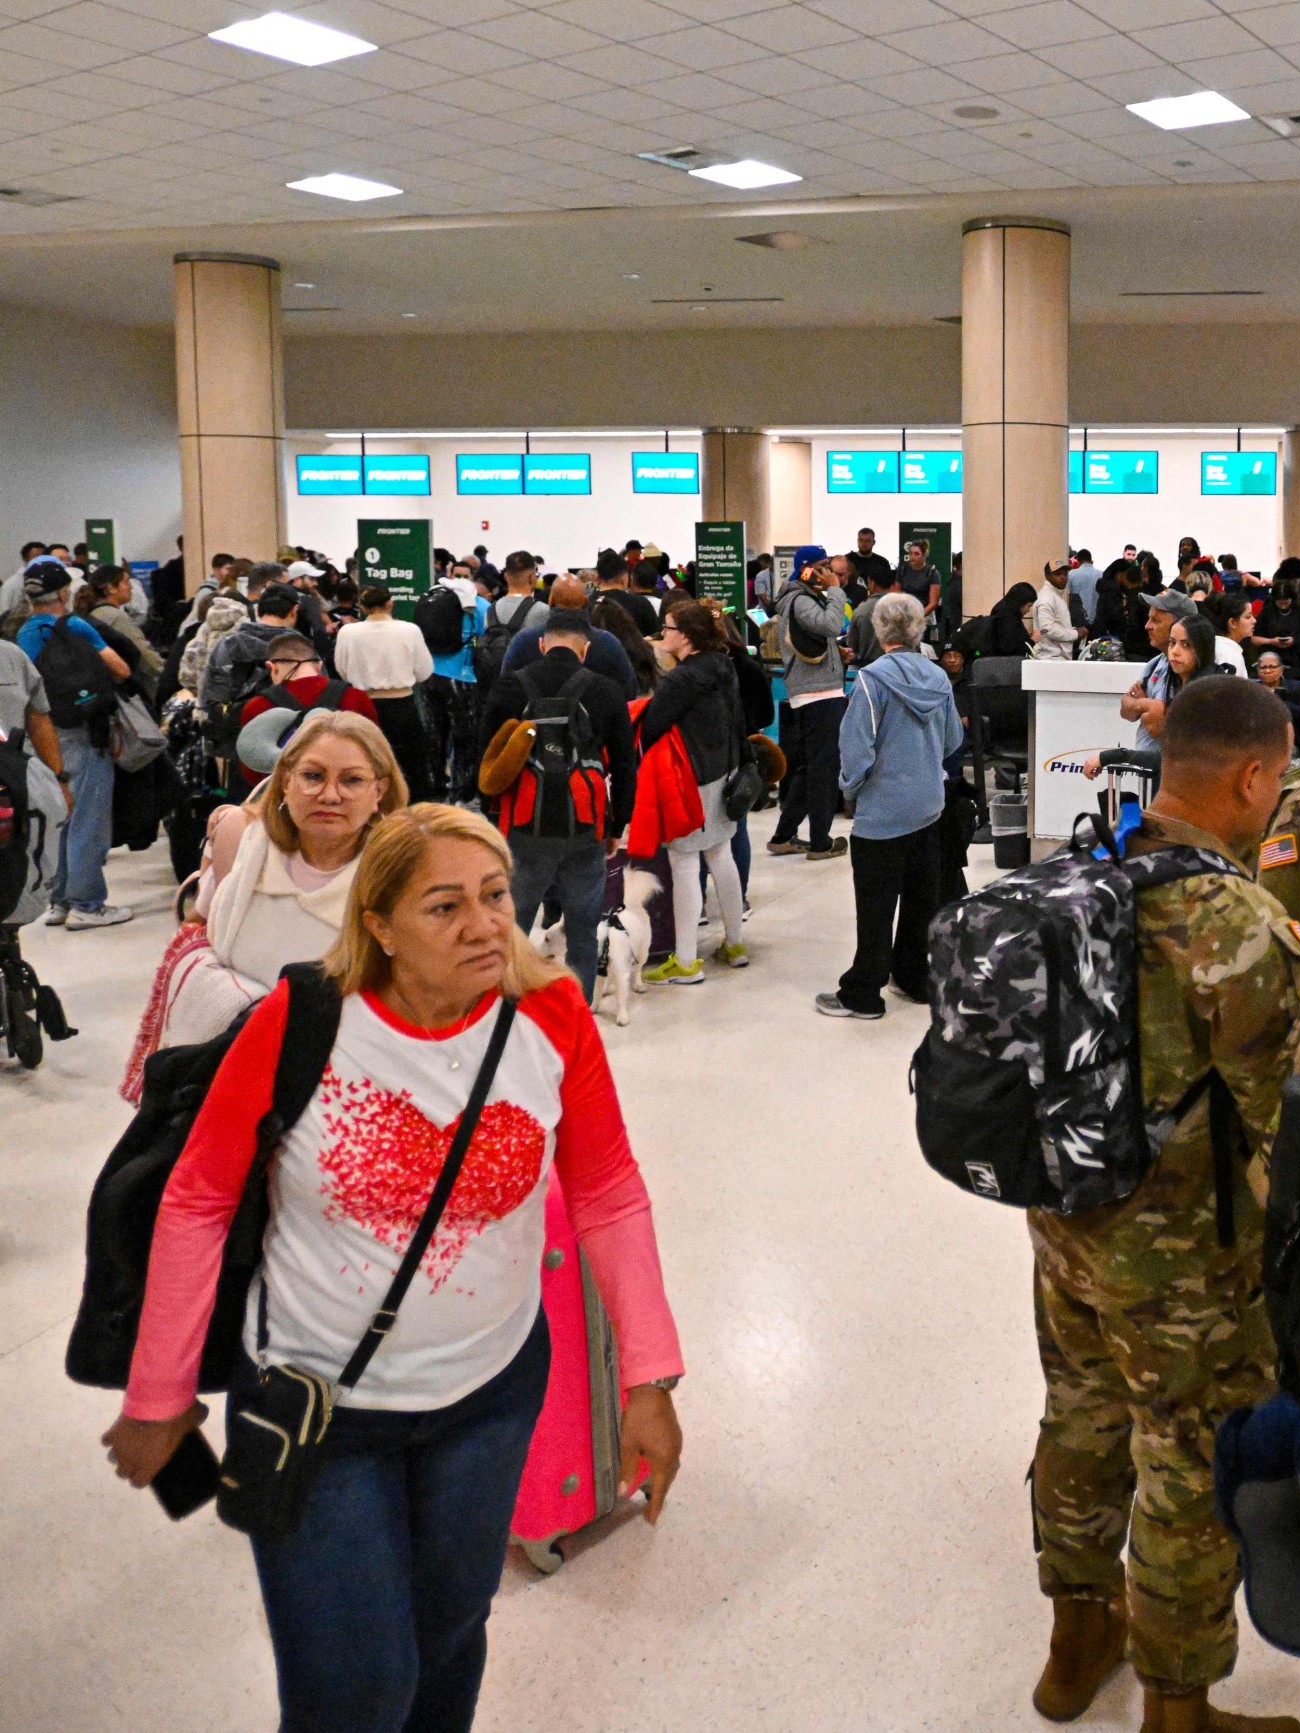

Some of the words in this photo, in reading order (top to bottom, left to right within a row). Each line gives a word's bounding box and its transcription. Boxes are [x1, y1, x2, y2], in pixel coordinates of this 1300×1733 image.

[698, 545, 725, 553] Entrega
[698, 553, 727, 561] Equipaje
[715, 560, 742, 568] Tamaño
[365, 567, 388, 580] Tag
[389, 567, 413, 580] Bag
